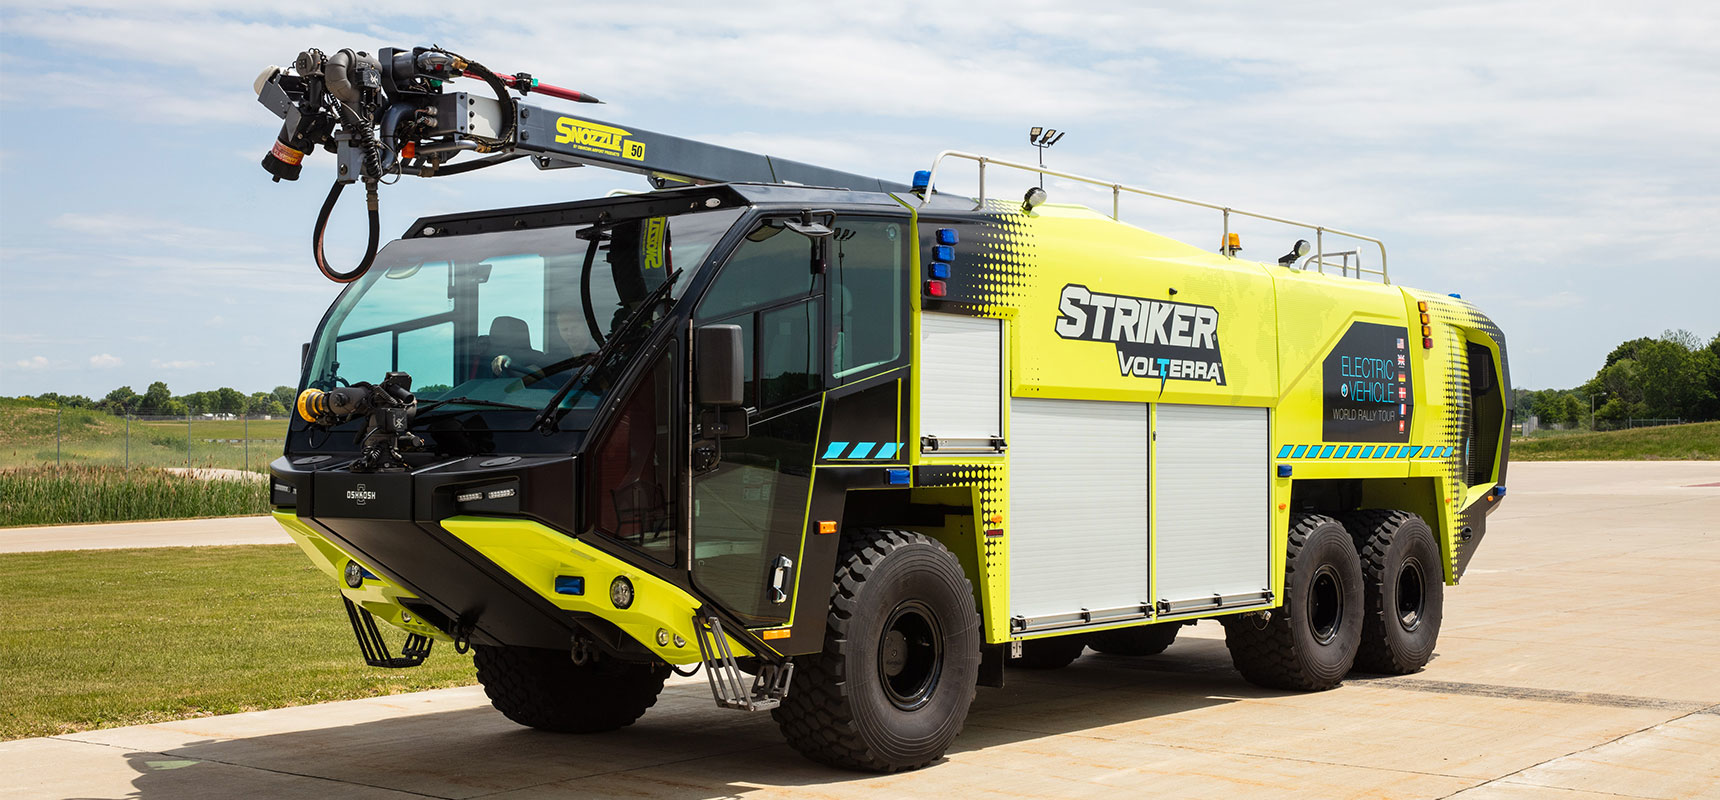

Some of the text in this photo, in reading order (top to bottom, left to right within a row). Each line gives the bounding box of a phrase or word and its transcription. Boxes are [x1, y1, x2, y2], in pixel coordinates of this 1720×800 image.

[555, 117, 632, 152] SNOZZLE
[631, 144, 643, 158] 50
[1341, 356, 1395, 381] ELECTRIC
[1349, 381, 1395, 403] VEHICLE
[1333, 408, 1395, 421] WORLD RALLY TOUR
[346, 490, 376, 500] OSHKOSH
